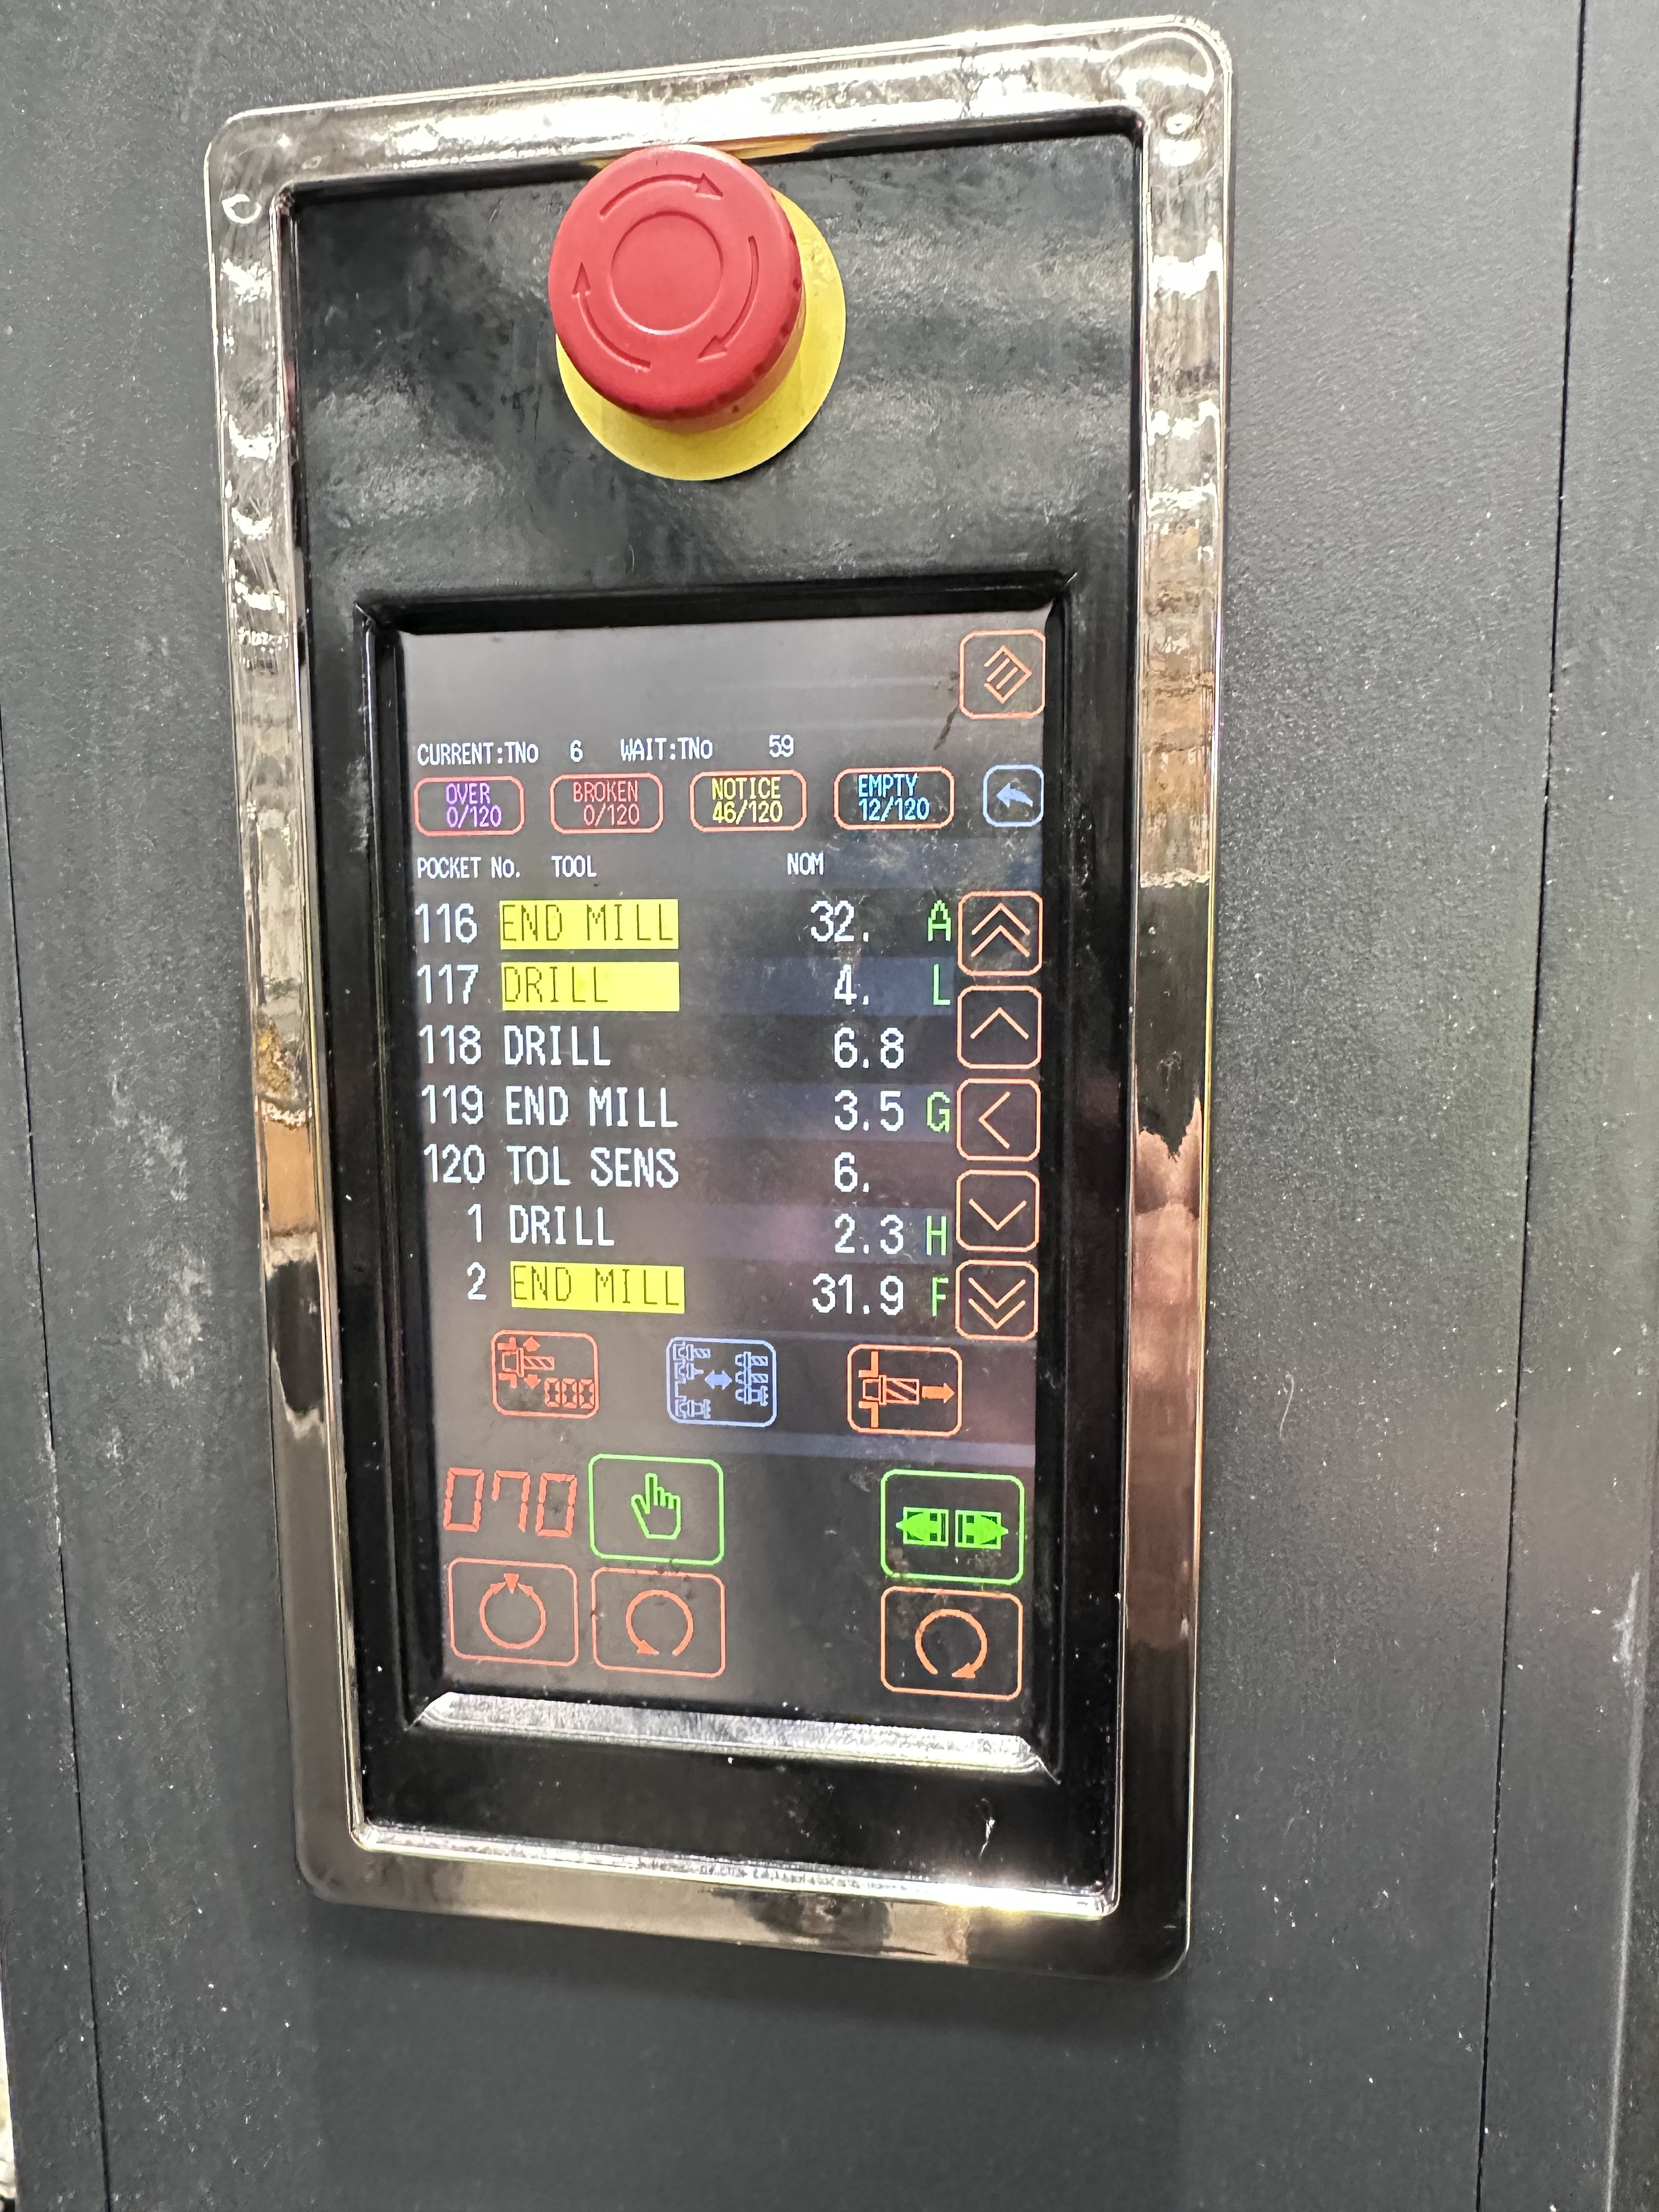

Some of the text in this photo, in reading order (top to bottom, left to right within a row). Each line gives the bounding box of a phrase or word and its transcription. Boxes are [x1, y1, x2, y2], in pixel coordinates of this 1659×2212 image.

[570, 740, 583, 763] 6
[769, 735, 794, 757] 59
[446, 783, 490, 804] OVER
[573, 780, 638, 803] BROKEN
[712, 777, 780, 800] NOTICE
[858, 773, 918, 798] EMPTY
[446, 805, 502, 828] 0/120
[583, 804, 640, 827] 0/120
[713, 800, 783, 825] 46/120
[859, 797, 929, 821] 12/120
[417, 856, 481, 879] POCKET
[551, 855, 596, 878] TOOL
[787, 852, 823, 875] NOM
[415, 900, 951, 944] 116 END MILL 32. A
[417, 964, 951, 1005] 117 DRILL 4. L
[419, 1025, 904, 1069] 118 DRILL 6.8
[421, 1085, 950, 1133] 119 END MILL 3.5 G
[424, 1144, 869, 1193] 120 TOL SENS 6.
[468, 1204, 947, 1256] 1 DRILL 2.3 H
[467, 1262, 949, 1317] 2 END MILL 31.9 F
[443, 1468, 577, 1538] 070
